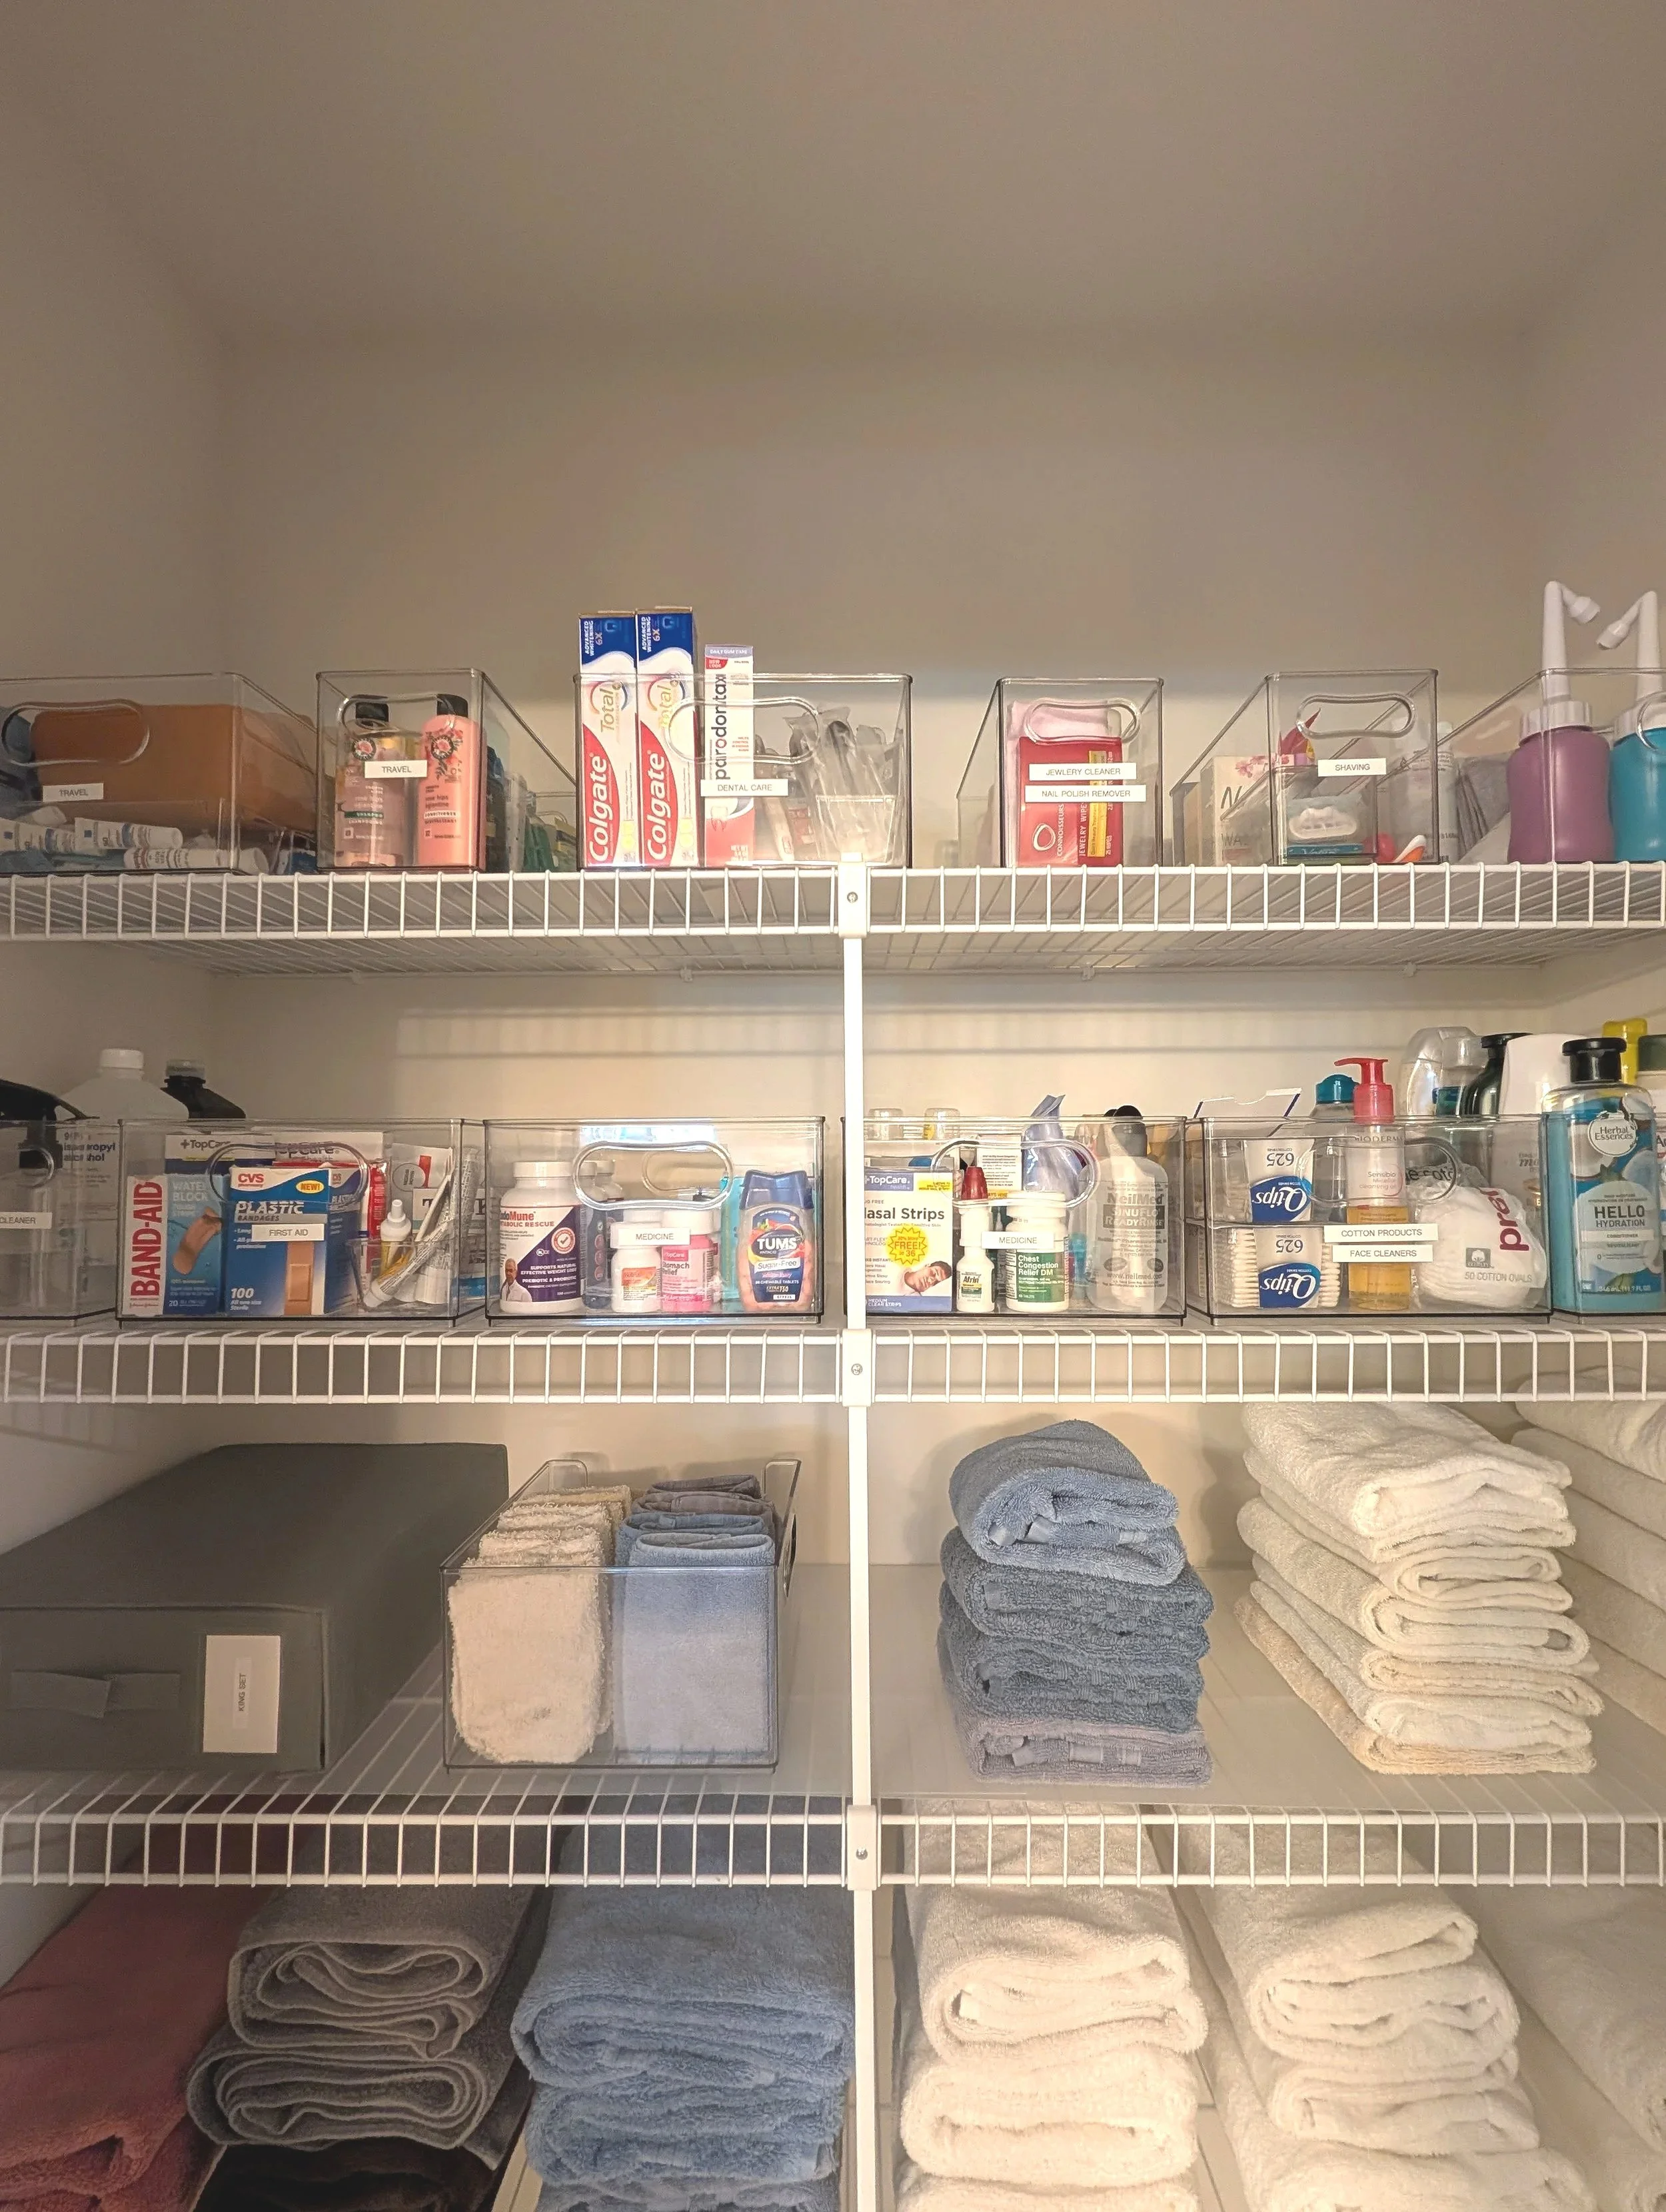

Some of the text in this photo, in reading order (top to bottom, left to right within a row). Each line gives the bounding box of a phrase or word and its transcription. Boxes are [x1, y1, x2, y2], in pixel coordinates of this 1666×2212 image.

[652, 628, 660, 642] 6X
[599, 688, 614, 732] Total
[588, 755, 613, 861] Colgate
[646, 753, 671, 860] Colgate
[1600, 1126, 1629, 1135] Herbal
[190, 1140, 231, 1151] TopCar
[1267, 1153, 1294, 1167] 625
[238, 1173, 264, 1183] CVS
[173, 1192, 209, 1201] BLOCK
[1108, 1193, 1163, 1205] NeilMed
[236, 1201, 305, 1215] PLASTIC
[1112, 1208, 1158, 1217] SINUFLO
[1593, 1205, 1645, 1219] HELLO
[901, 1207, 945, 1222] Strips
[1596, 1219, 1645, 1228] HYDRATION
[131, 1181, 162, 1296] BAND-AID
[757, 1237, 798, 1251] TUMS
[894, 1241, 921, 1250] FREE!
[1275, 1239, 1303, 1253] 625
[757, 1260, 797, 1270] Sugar-Free
[1018, 1261, 1059, 1270] Congestion
[963, 1275, 980, 1284] Afrin
[1477, 1272, 1507, 1281] COTTON
[1509, 1273, 1532, 1283] OVALS
[231, 1288, 254, 1299] 100
